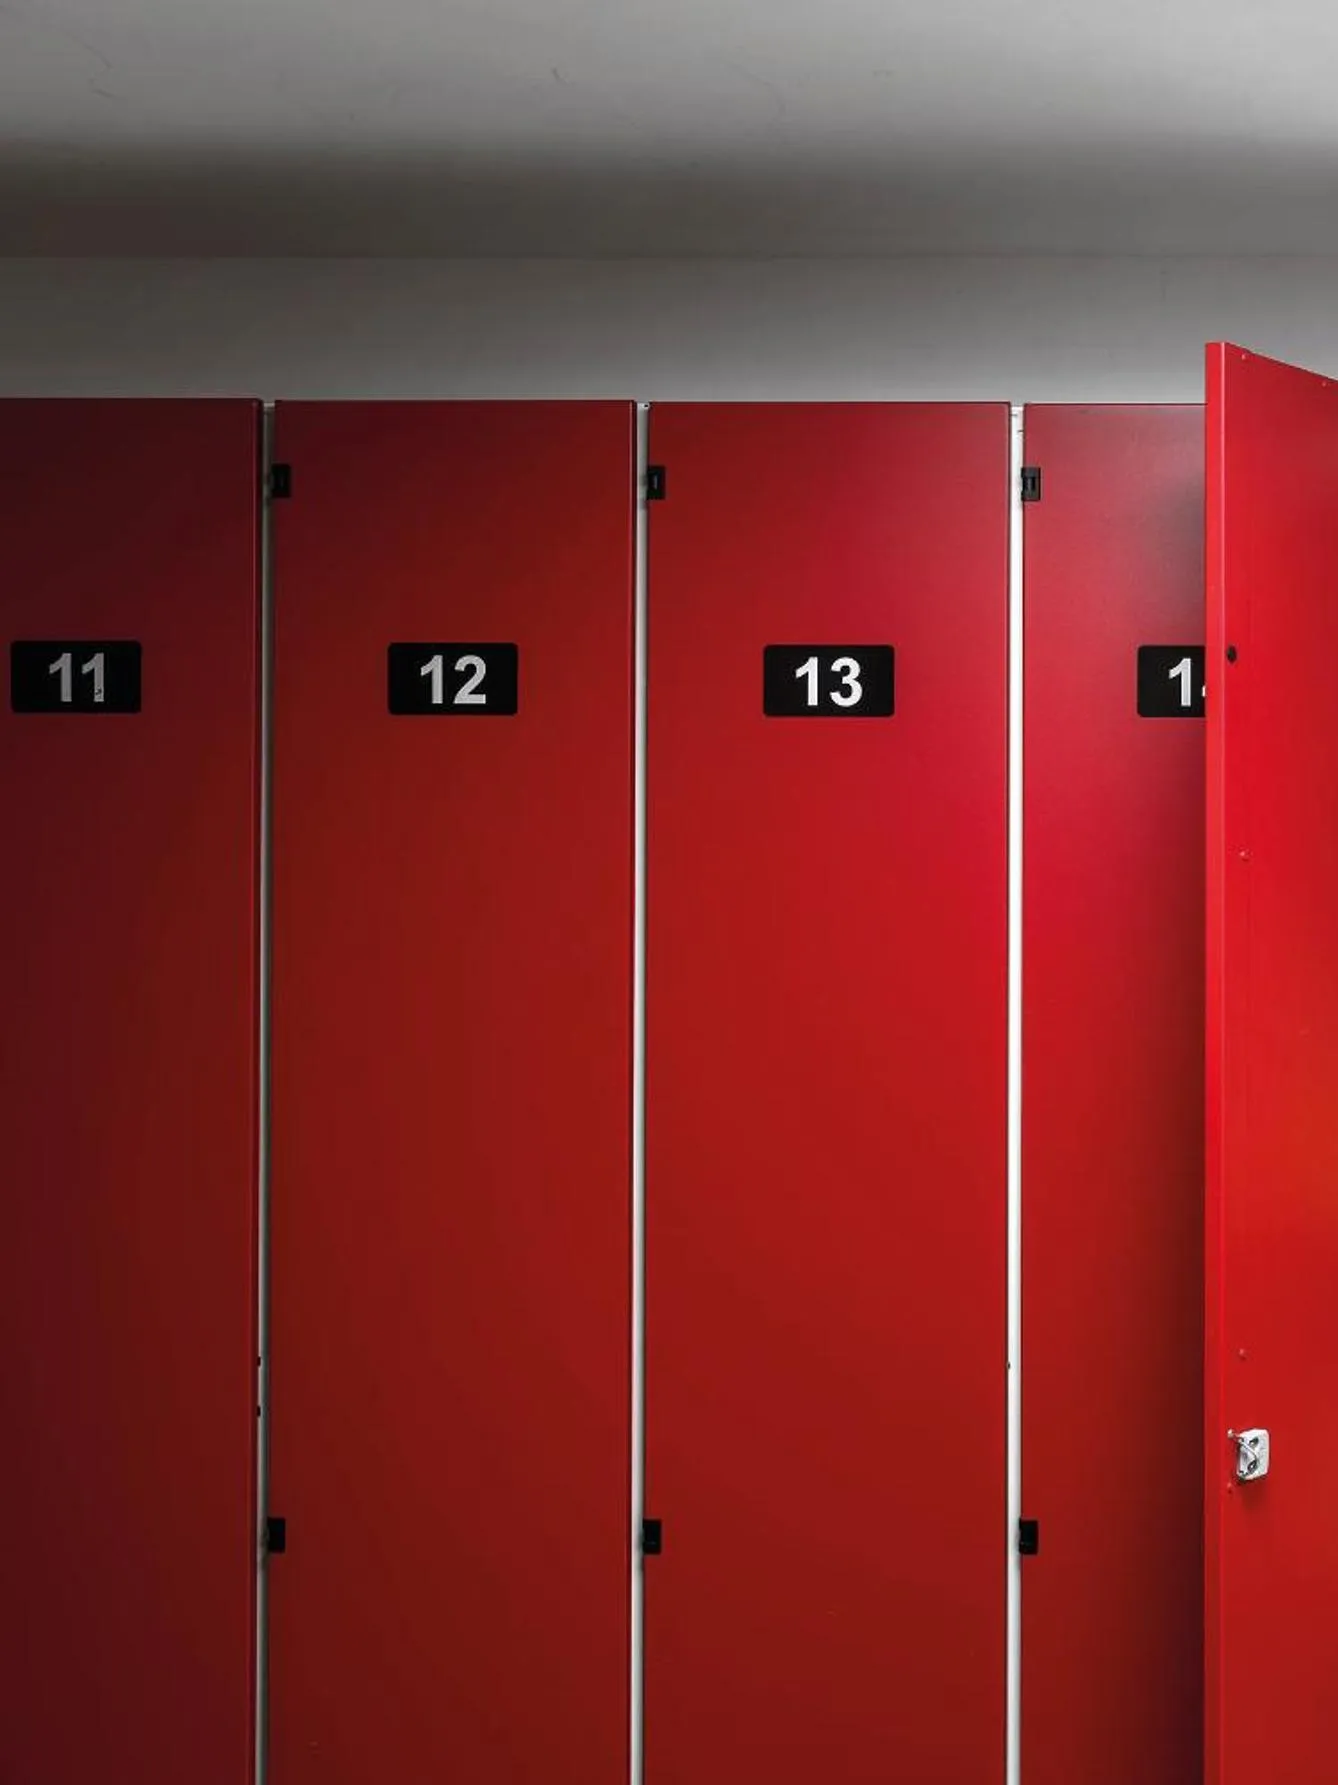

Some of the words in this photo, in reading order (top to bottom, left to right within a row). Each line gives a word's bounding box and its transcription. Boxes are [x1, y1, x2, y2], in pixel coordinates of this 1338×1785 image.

[49, 652, 105, 703] 11
[420, 654, 487, 705] 12
[795, 656, 863, 707] 13
[1168, 657, 1206, 707] 1
